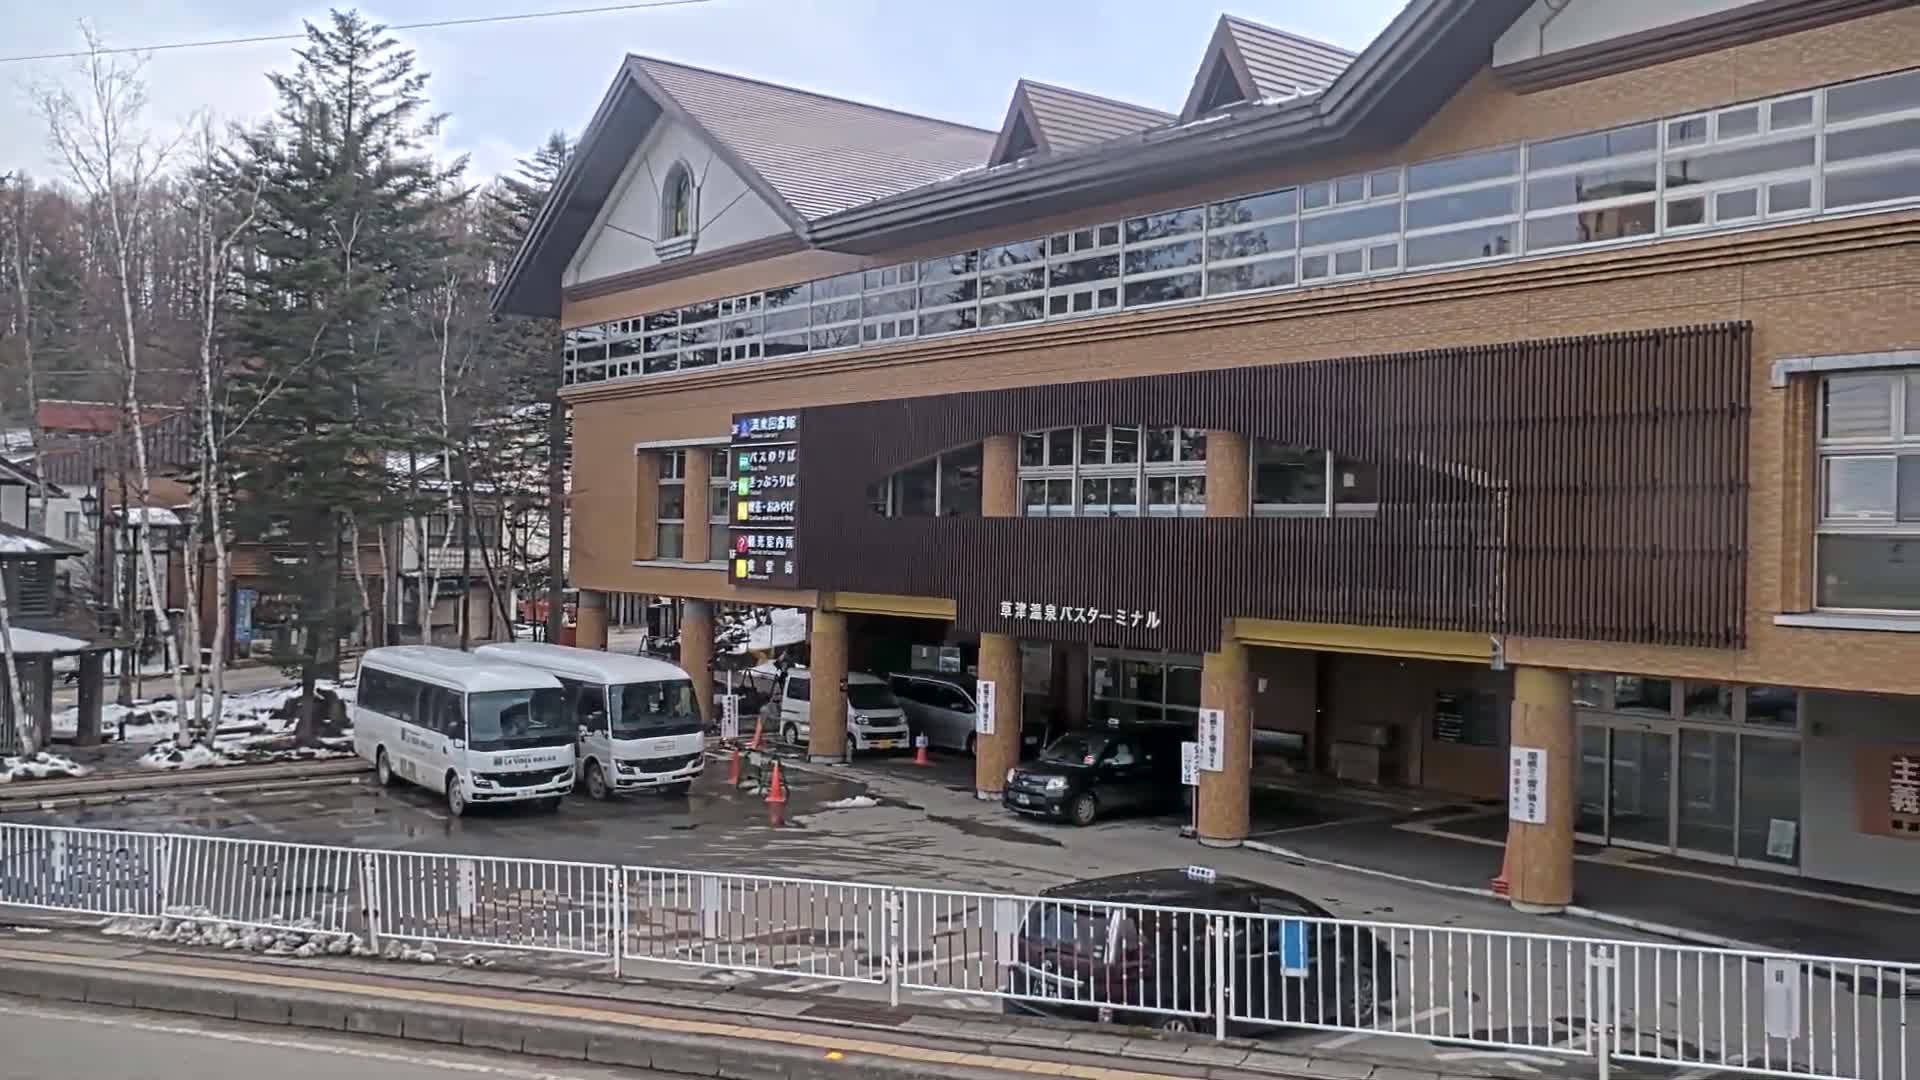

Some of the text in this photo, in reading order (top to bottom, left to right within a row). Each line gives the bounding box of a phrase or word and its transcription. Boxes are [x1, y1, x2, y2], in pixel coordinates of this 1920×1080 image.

[749, 448, 797, 462] バスのりば
[749, 474, 797, 489] きっぷうりば
[748, 535, 794, 549] 観光案内所
[1000, 601, 1161, 629] 草津温泉バスターミナル
